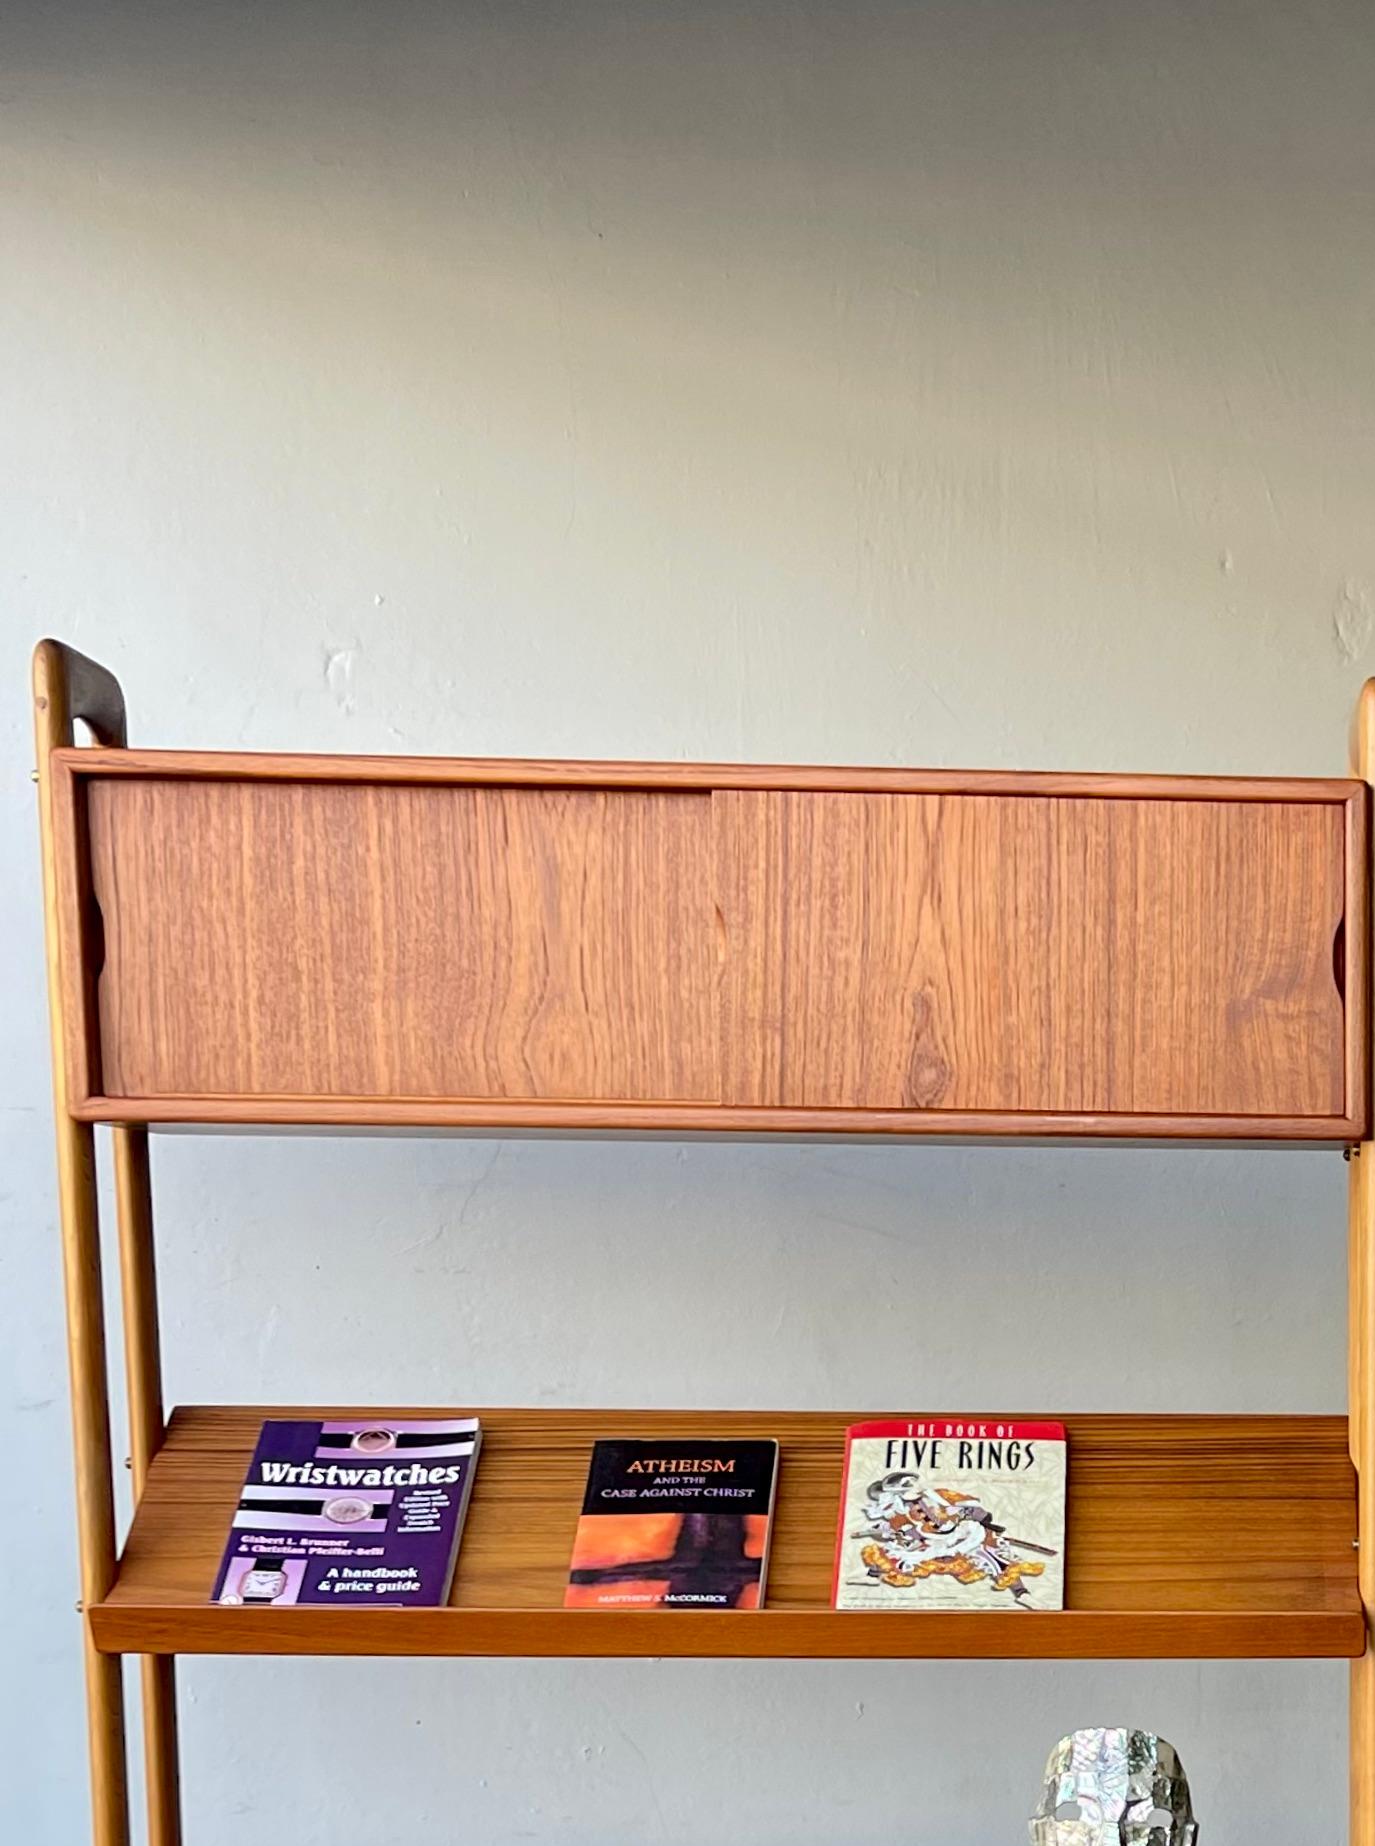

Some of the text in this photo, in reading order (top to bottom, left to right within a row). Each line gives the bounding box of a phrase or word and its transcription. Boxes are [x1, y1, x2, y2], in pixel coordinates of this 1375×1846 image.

[907, 1423, 1014, 1438] THE BOOK OF
[886, 1439, 1035, 1471] FIVE RINGS
[626, 1459, 737, 1473] ATHEISM
[260, 1462, 461, 1486] Wristwatches
[653, 1476, 706, 1485] AND THE
[601, 1487, 756, 1498] CASE AGAINST CHRIST
[240, 1535, 285, 1545] Gisbert
[299, 1537, 350, 1547] Brunner
[238, 1544, 249, 1552] &
[251, 1544, 306, 1554] Christian
[326, 1567, 418, 1579] A handbook
[317, 1580, 421, 1593] & price guide
